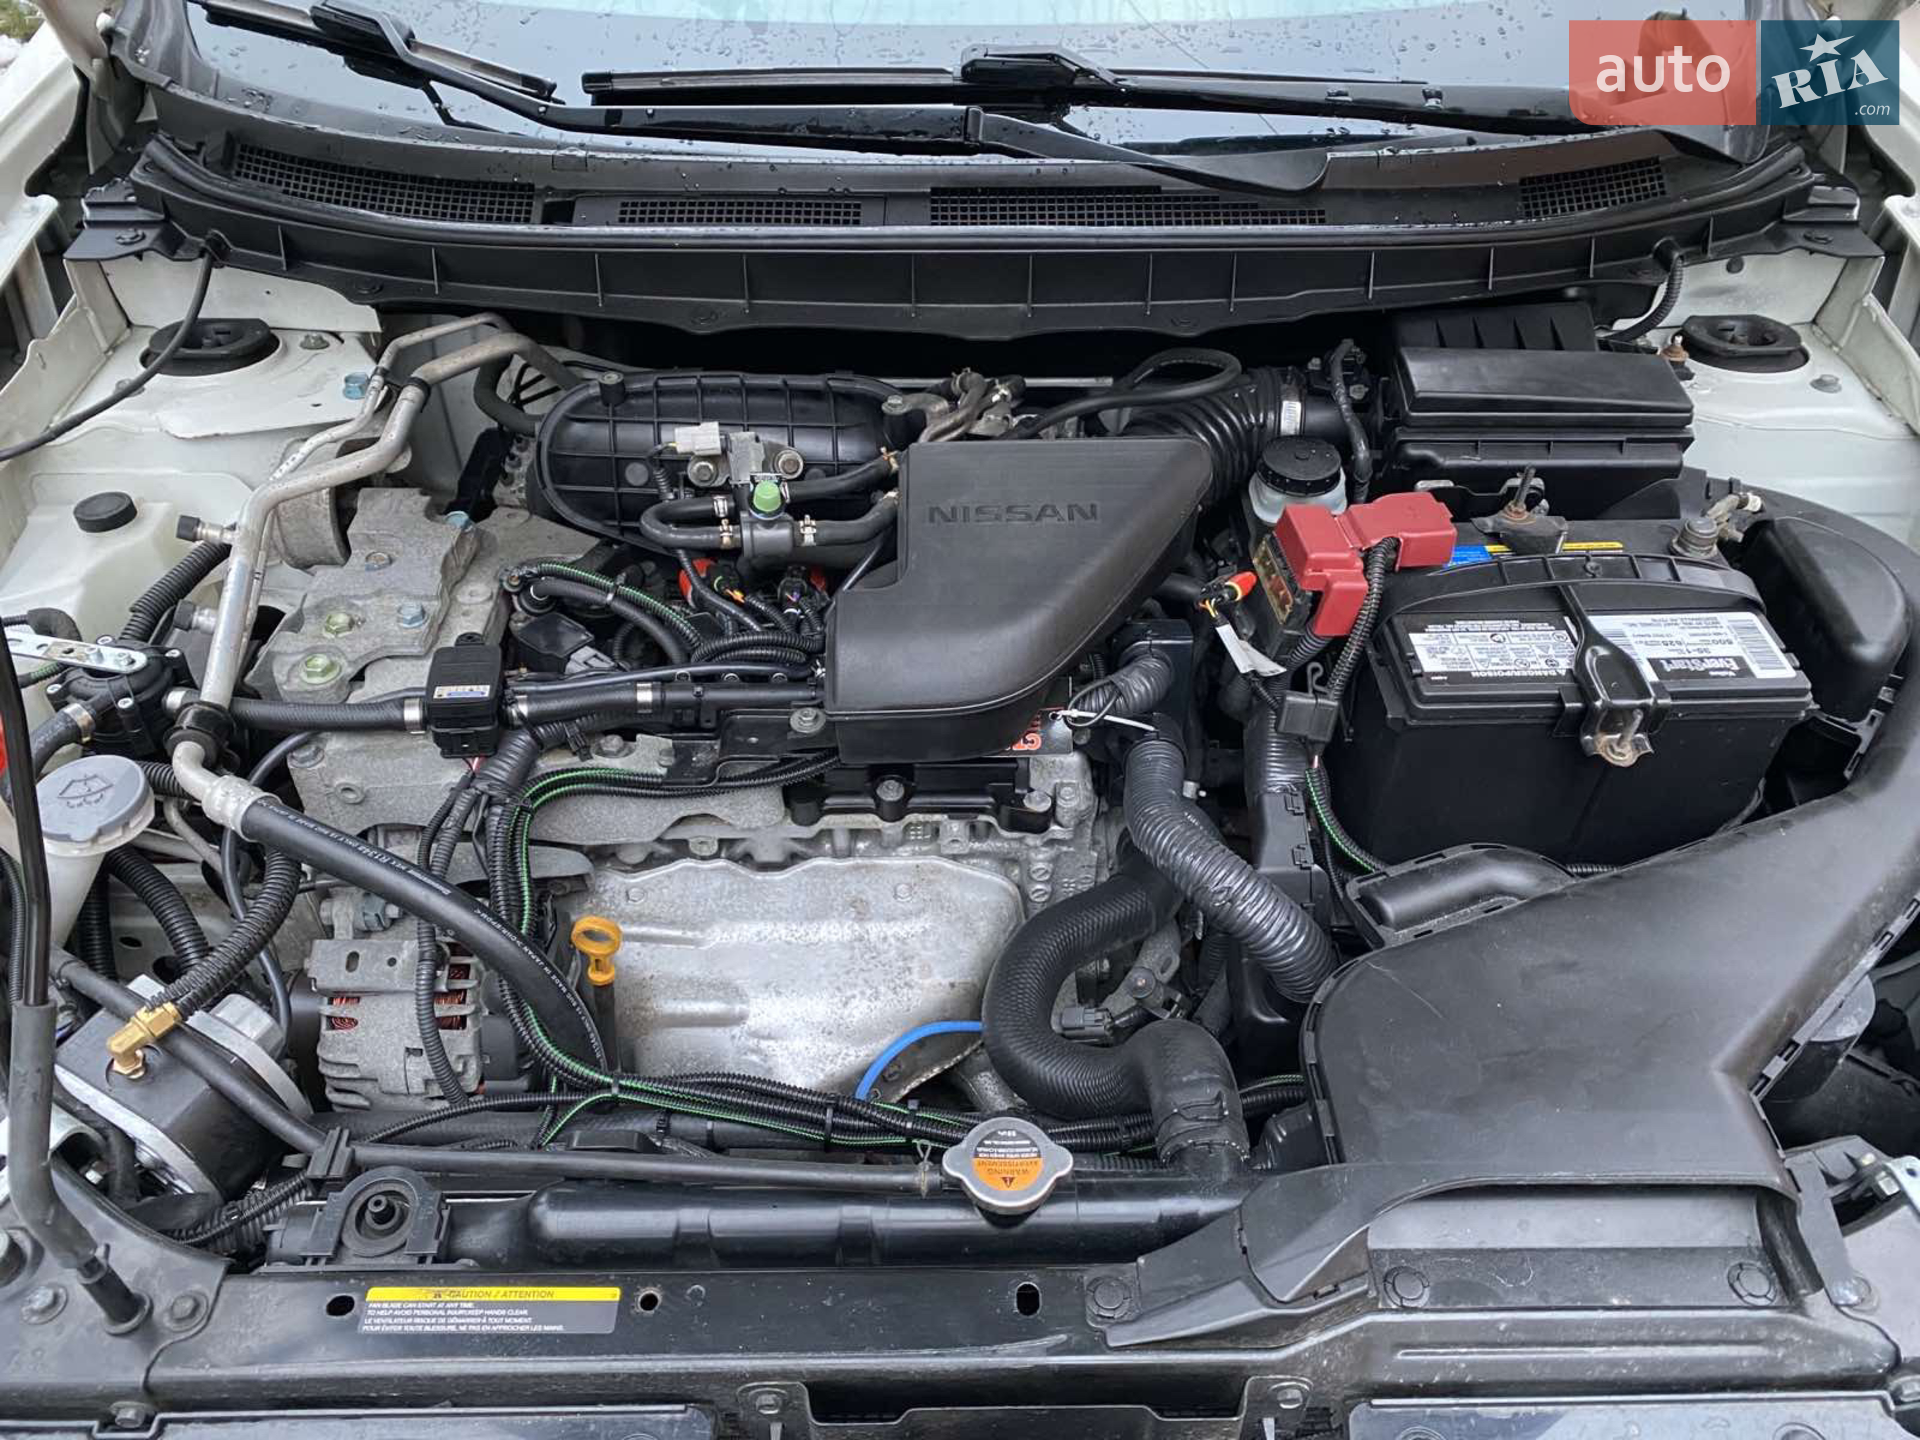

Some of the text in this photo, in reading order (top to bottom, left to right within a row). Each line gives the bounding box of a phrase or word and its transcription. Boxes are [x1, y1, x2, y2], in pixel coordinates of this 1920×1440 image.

[928, 502, 1098, 524] NISSAN
[1660, 658, 1740, 672] EverStart
[522, 946, 545, 967] JAPAN
[448, 1290, 492, 1299] CAUTION
[502, 1290, 554, 1299] ATTENTION
